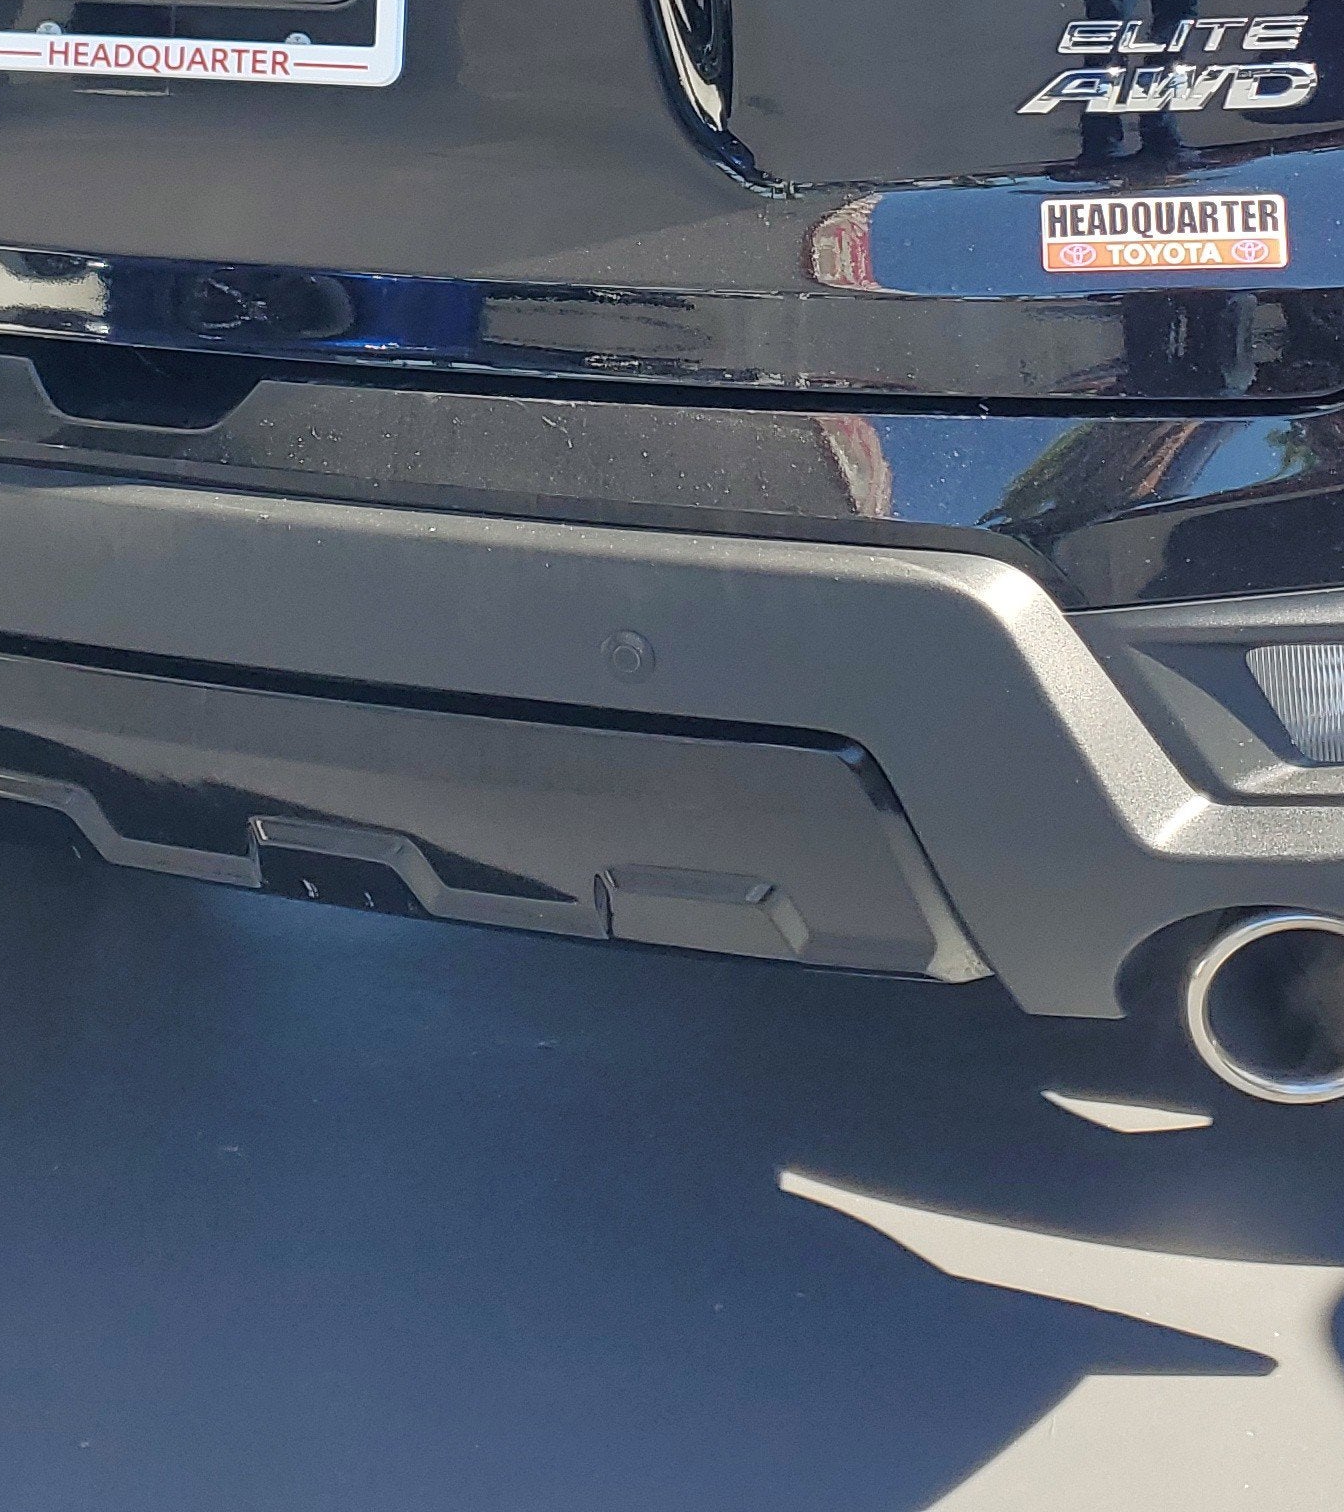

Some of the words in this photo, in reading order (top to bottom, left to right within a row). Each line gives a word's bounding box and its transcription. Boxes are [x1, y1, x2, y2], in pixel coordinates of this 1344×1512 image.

[1058, 15, 1308, 53] ELITE
[47, 40, 292, 76] HEADQUARTER
[1016, 62, 1319, 114] AWD
[1047, 199, 1279, 238] HEADQUARTER
[1106, 242, 1223, 265] TOYOTA
